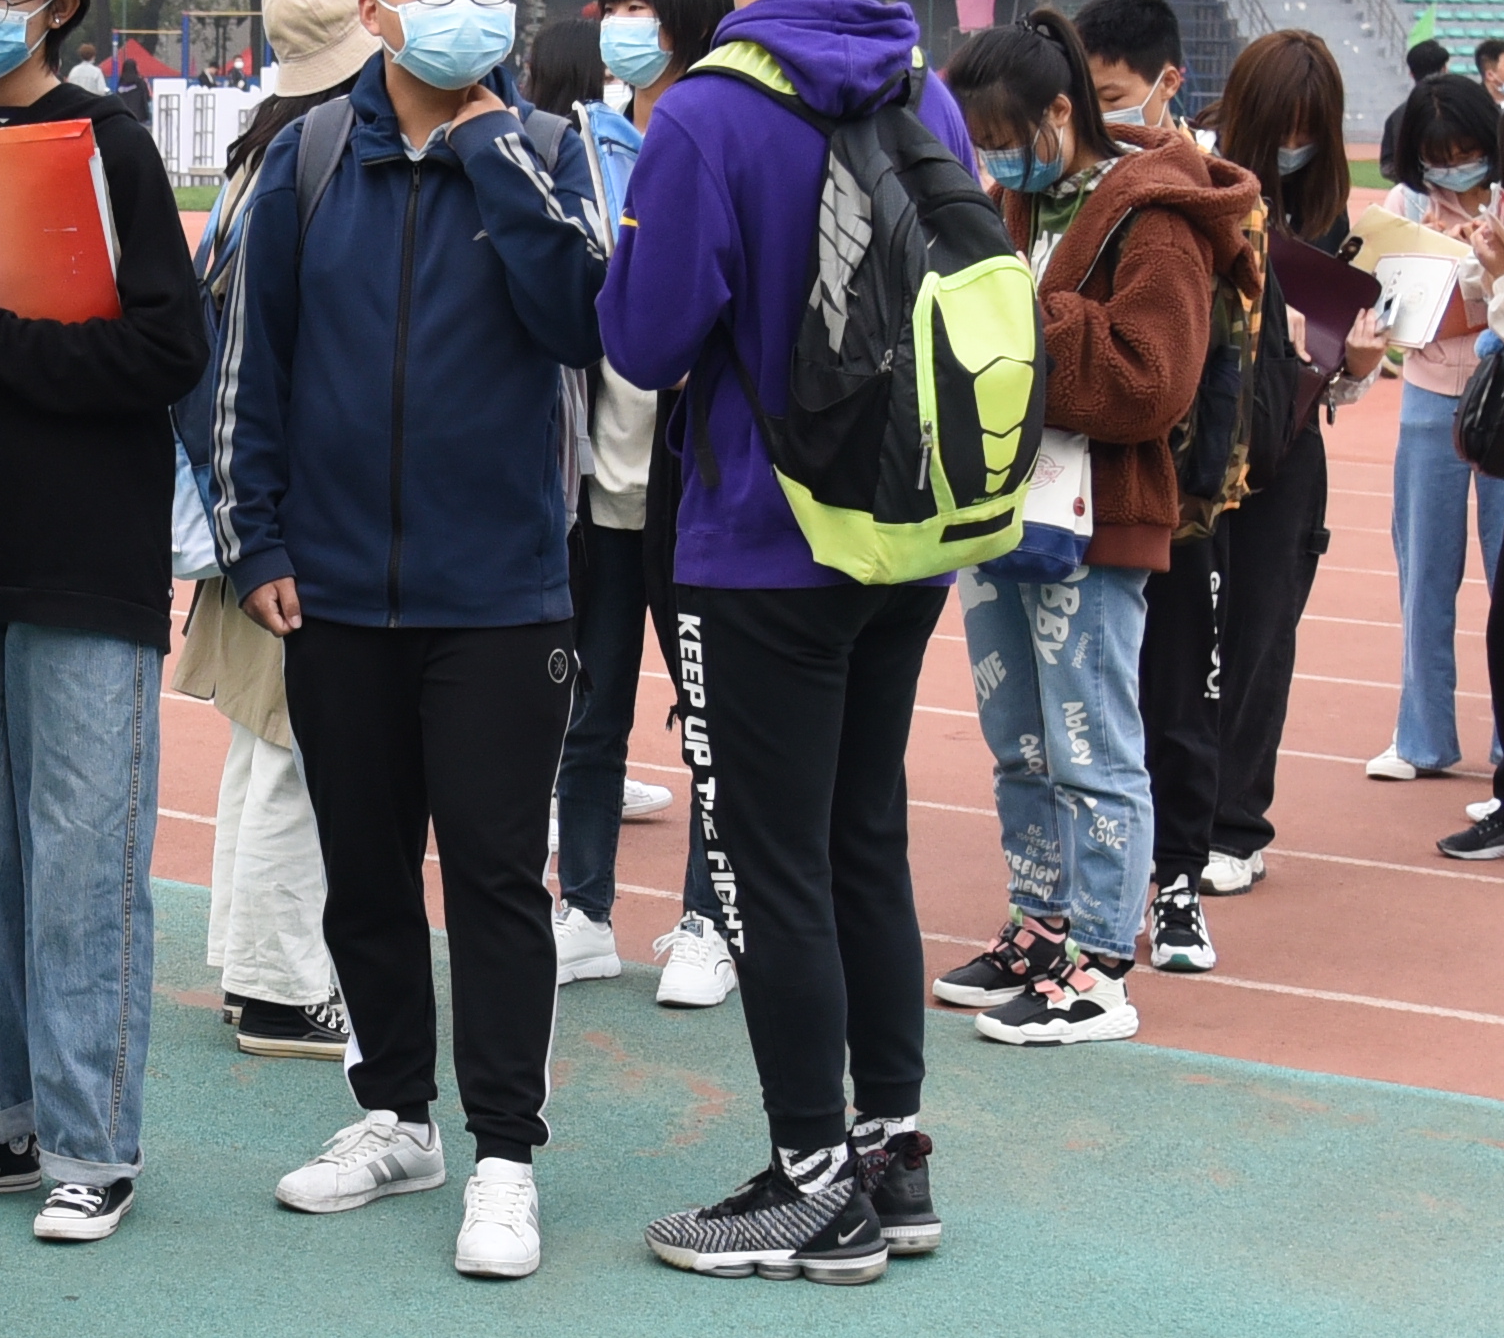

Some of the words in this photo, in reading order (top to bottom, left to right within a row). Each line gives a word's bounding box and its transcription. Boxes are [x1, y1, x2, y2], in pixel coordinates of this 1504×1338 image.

[677, 613, 706, 709] KEEP
[973, 650, 1008, 711] OVE
[684, 715, 713, 767] UP
[1004, 849, 1061, 883] OREIGN
[707, 850, 745, 954] FIGHT
